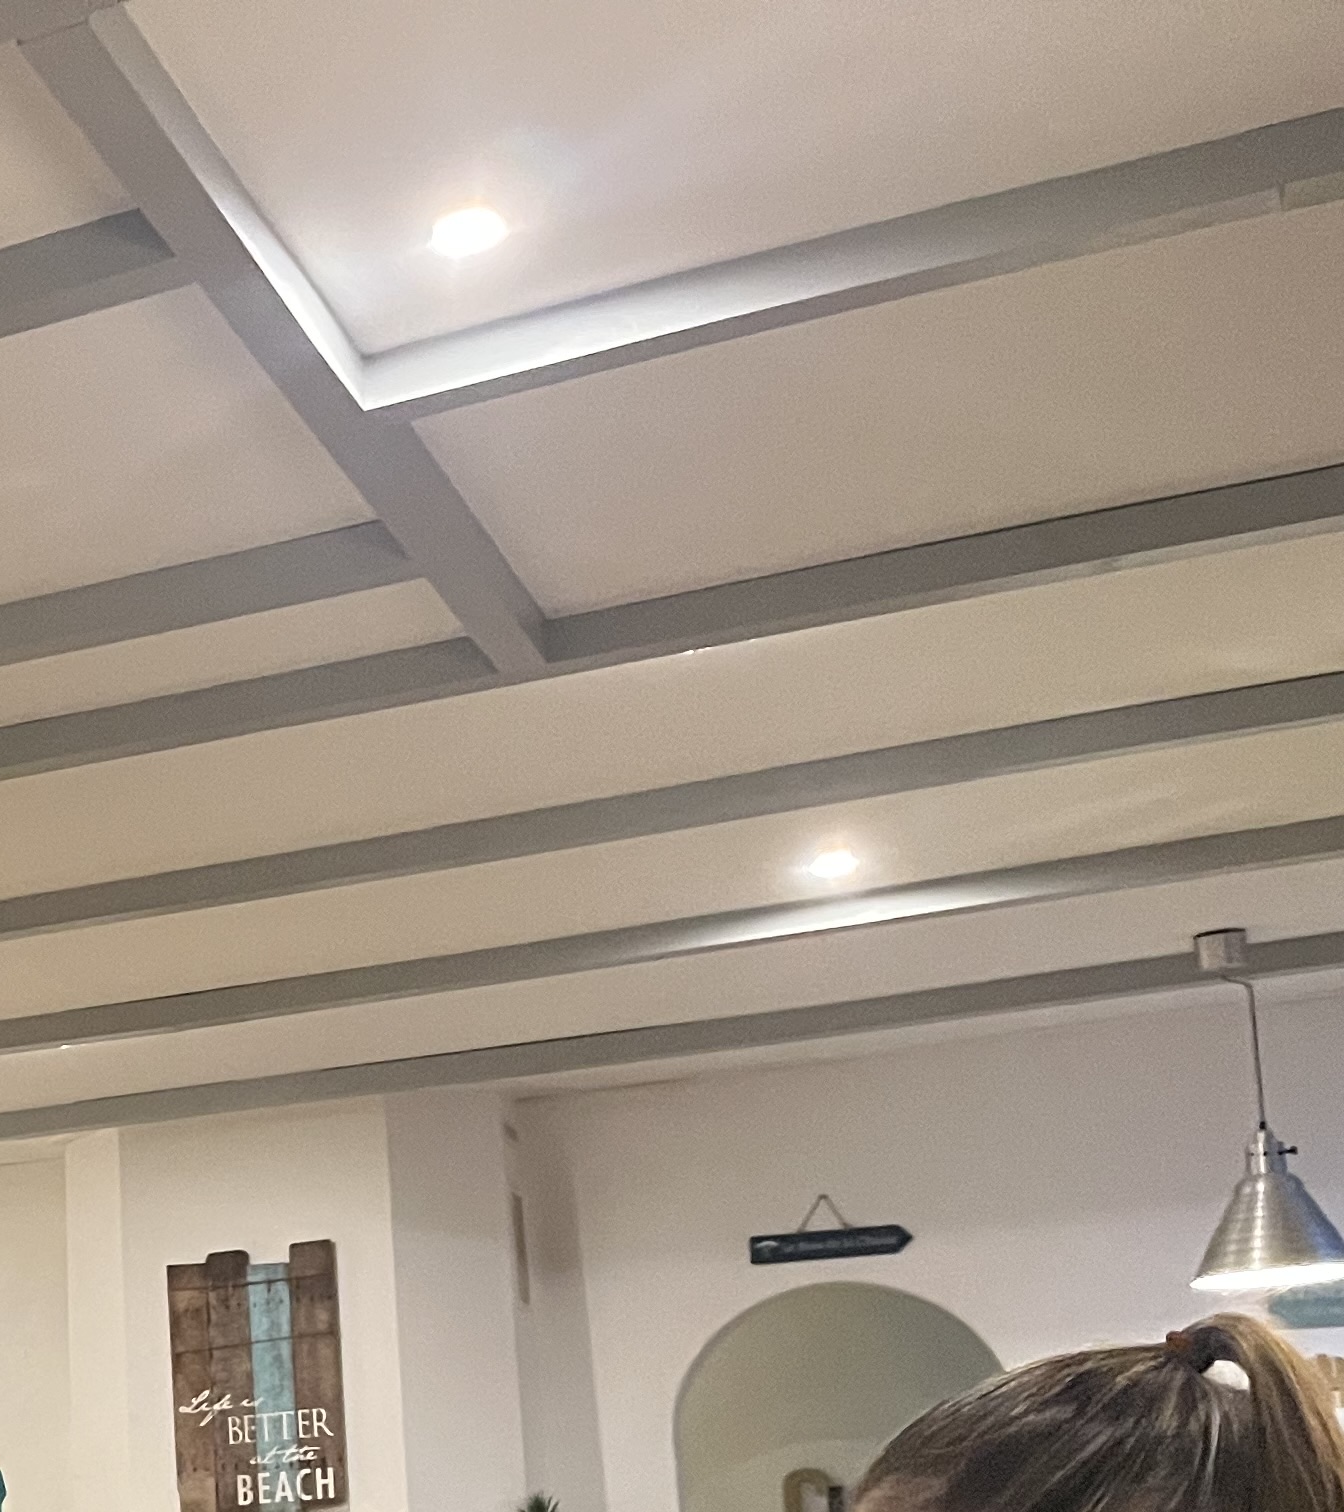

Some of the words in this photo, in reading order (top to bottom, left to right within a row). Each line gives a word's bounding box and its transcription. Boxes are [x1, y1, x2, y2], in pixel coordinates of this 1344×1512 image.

[178, 1389, 234, 1427] Life
[227, 1407, 335, 1445] BETTER
[236, 1466, 336, 1506] BEACH
